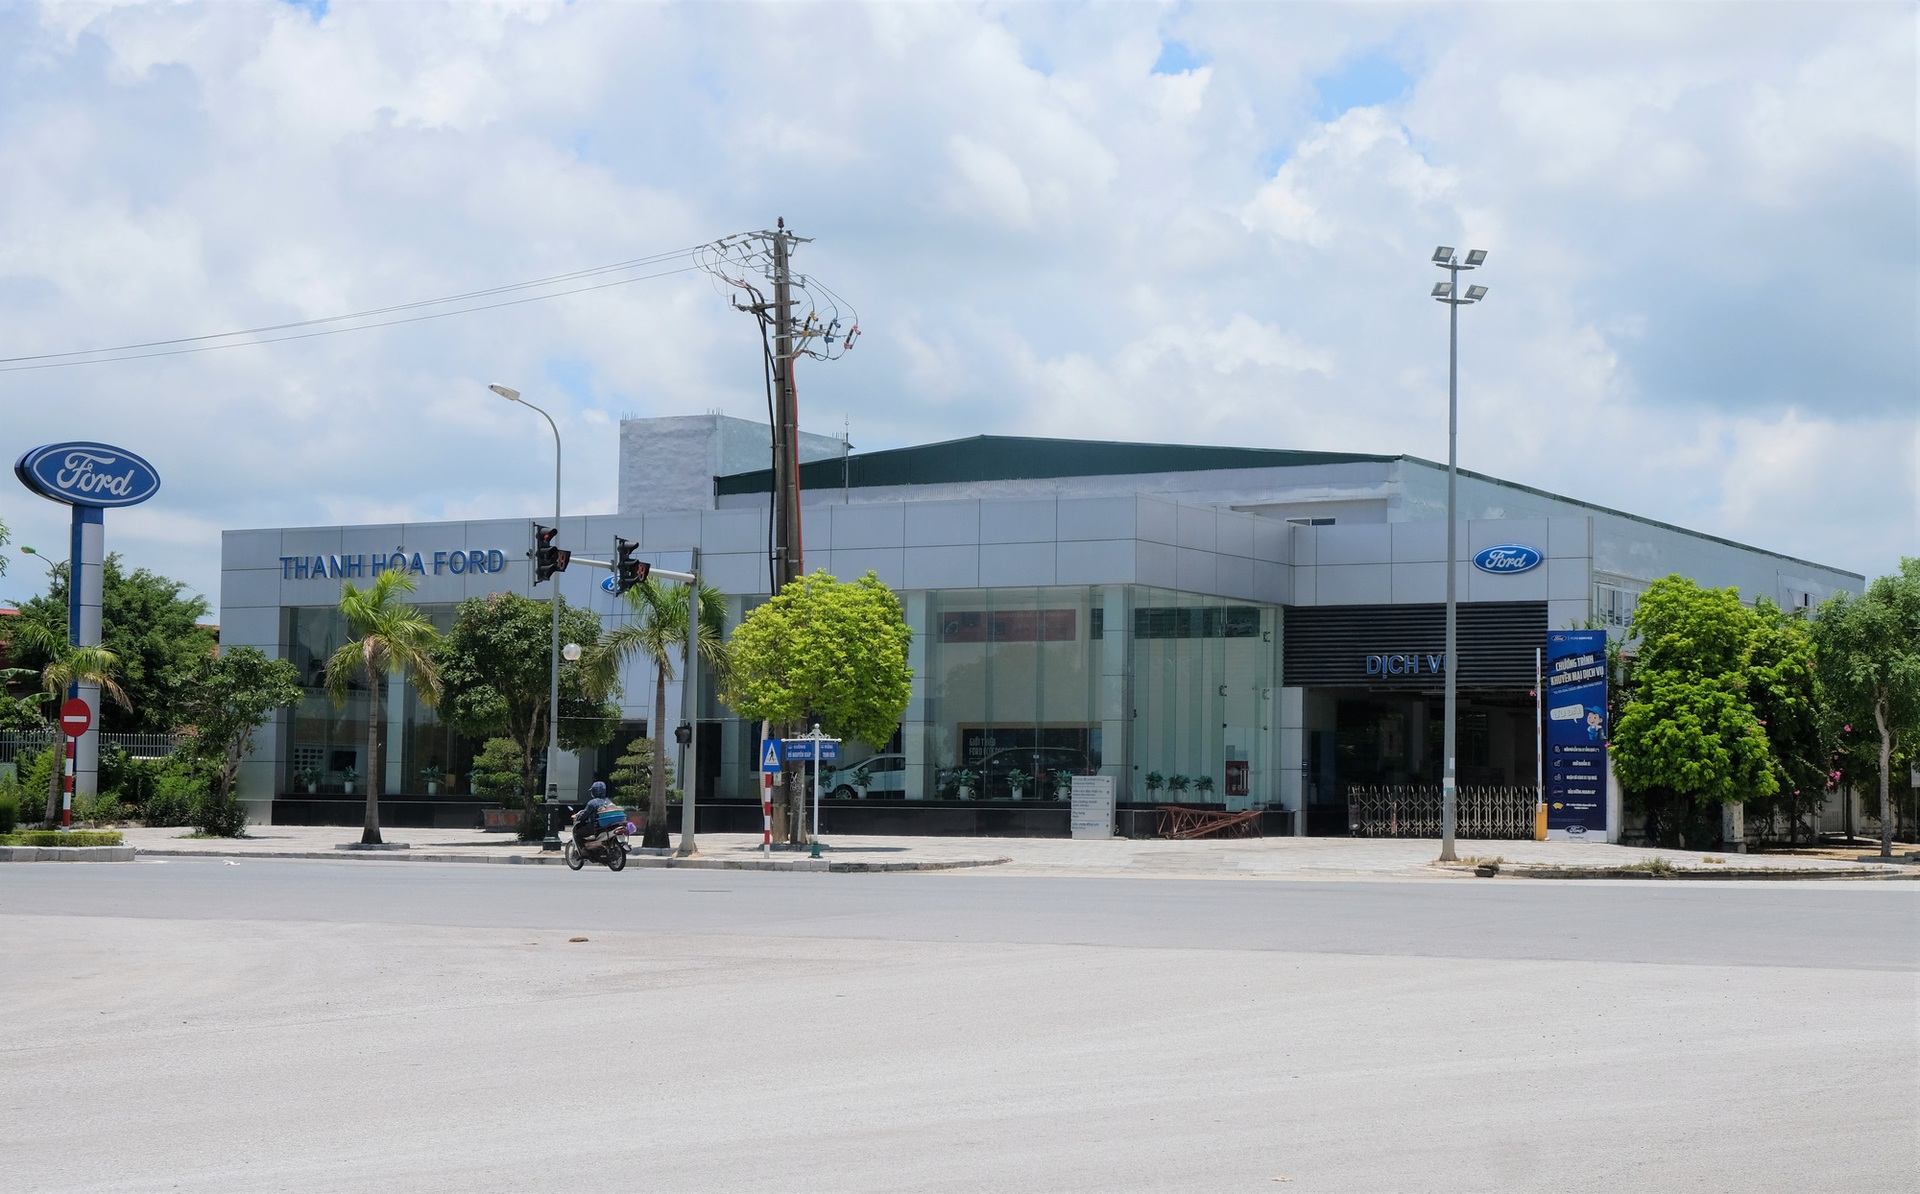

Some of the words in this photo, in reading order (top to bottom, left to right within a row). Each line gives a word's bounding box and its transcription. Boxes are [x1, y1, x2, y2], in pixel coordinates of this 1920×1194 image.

[57, 452, 134, 496] Ford
[279, 553, 362, 580] THANH
[372, 546, 426, 578] HÓA
[433, 549, 506, 575] FORD
[1485, 549, 1527, 568] Ford
[1366, 655, 1419, 679] DỊCH
[1577, 654, 1594, 667] TRÌNH
[1596, 665, 1604, 677] VỤ
